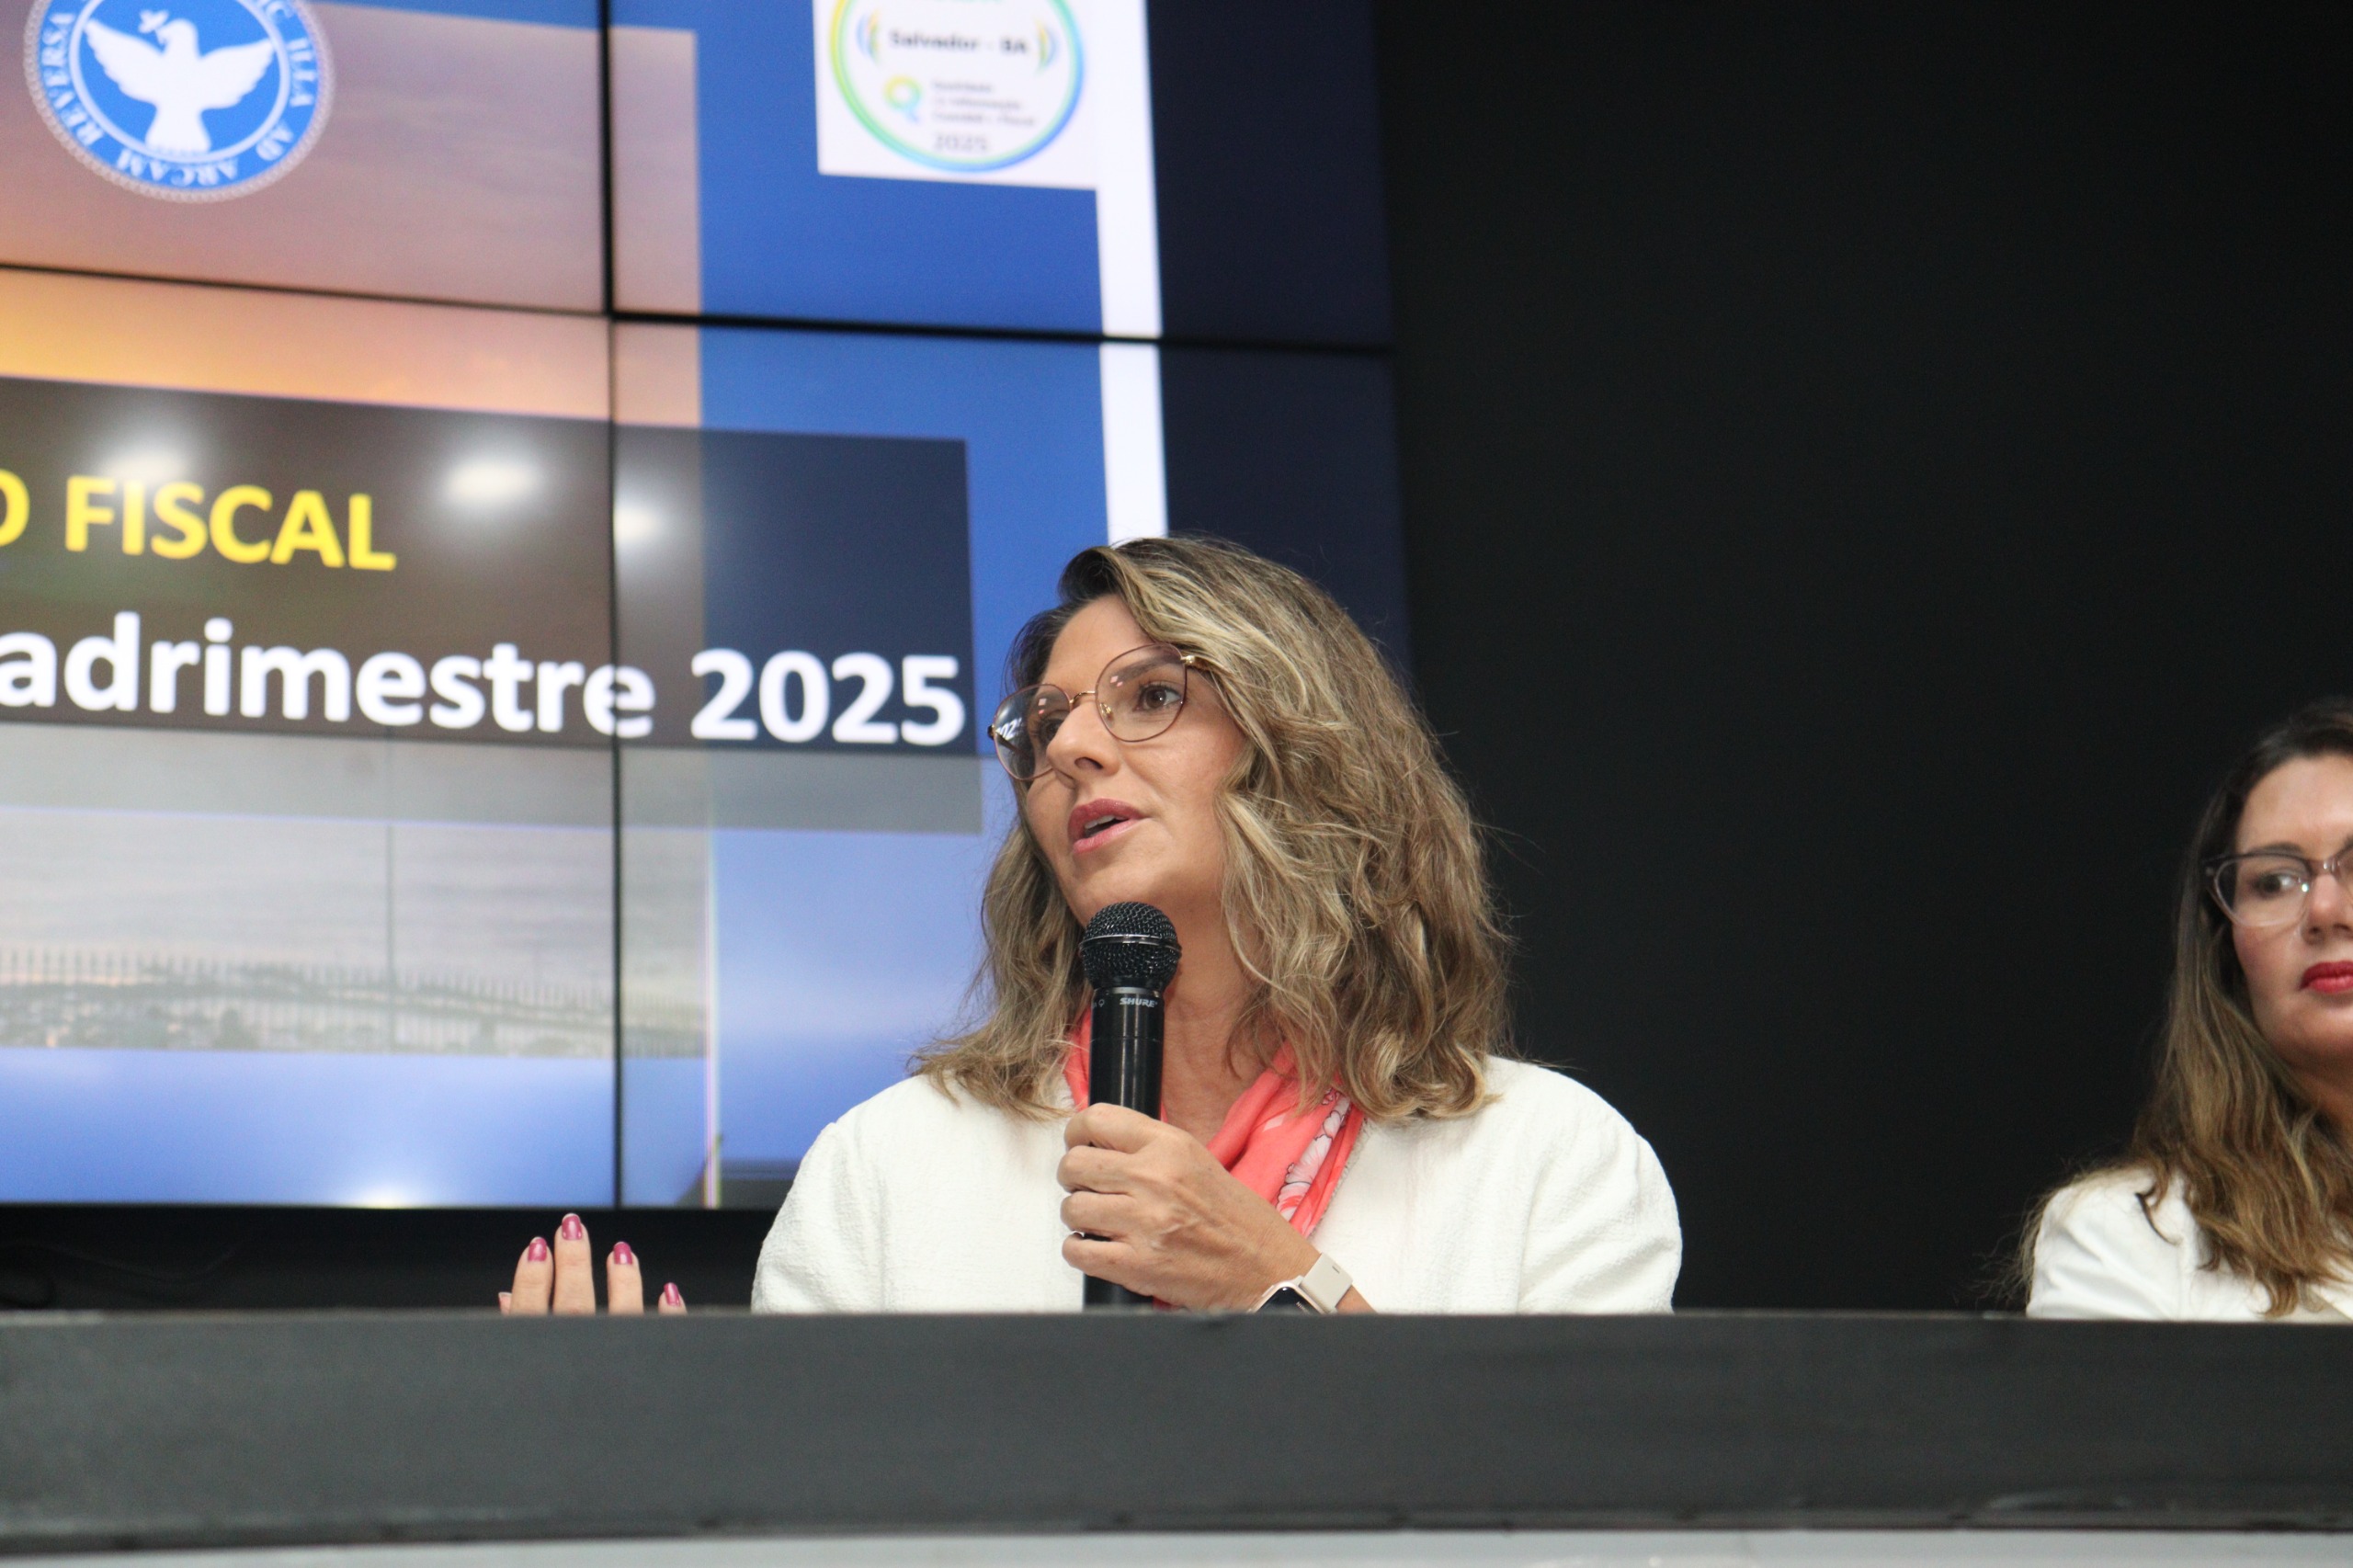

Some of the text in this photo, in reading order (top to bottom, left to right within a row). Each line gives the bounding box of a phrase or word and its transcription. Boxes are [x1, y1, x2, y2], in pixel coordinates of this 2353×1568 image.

[889, 28, 980, 51] Salvador
[117, 146, 239, 187] ARCAM
[64, 474, 397, 572] FISCAL
[690, 648, 965, 745] 2025
[1119, 996, 1155, 1008] SHURE
